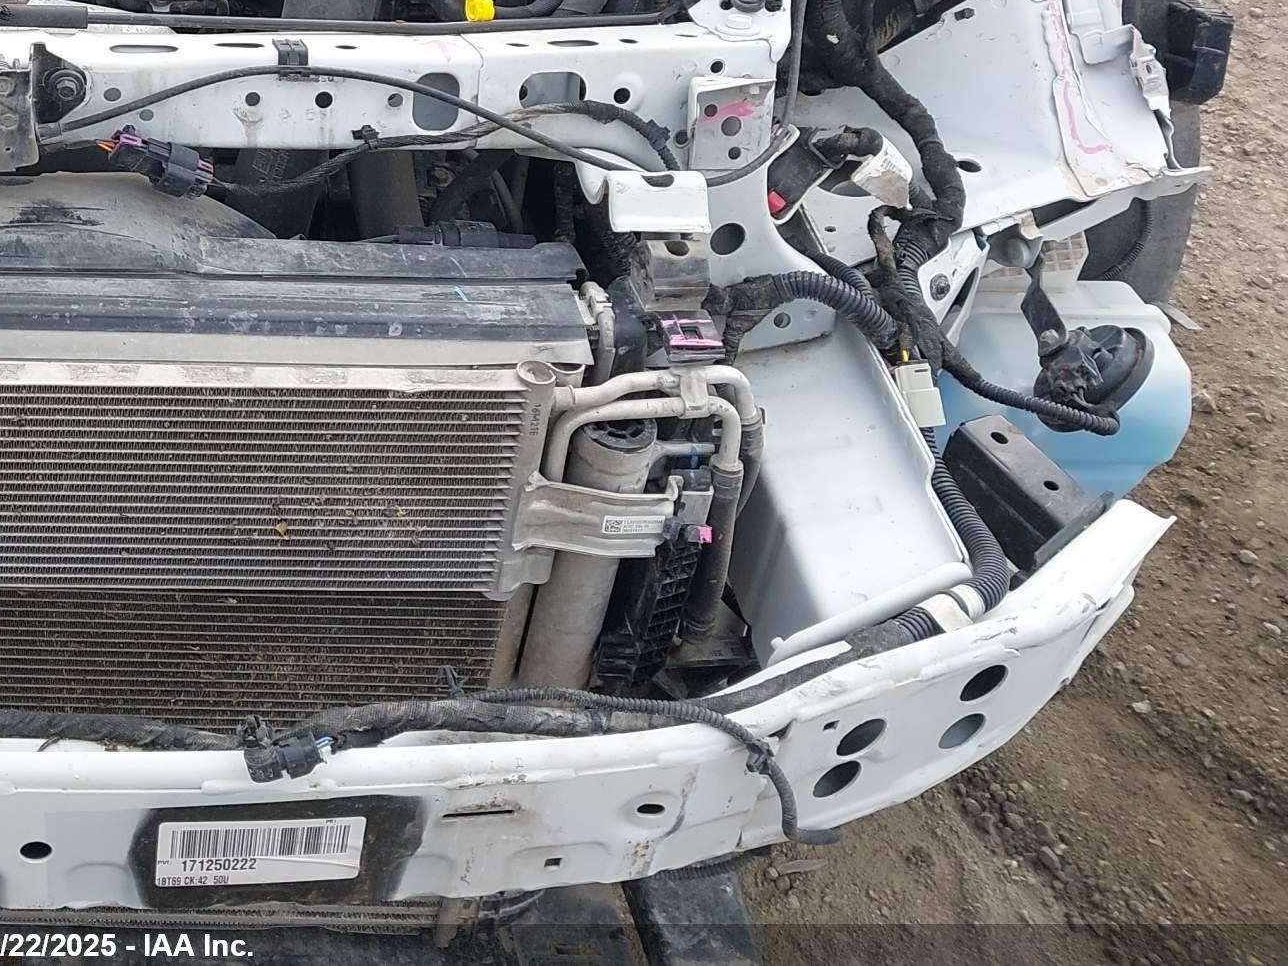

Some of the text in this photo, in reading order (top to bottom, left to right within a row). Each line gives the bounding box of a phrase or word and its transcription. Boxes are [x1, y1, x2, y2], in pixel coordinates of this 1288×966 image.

[181, 858, 257, 872] 171250222
[184, 875, 208, 885] CK:42
[213, 875, 230, 884] 50U
